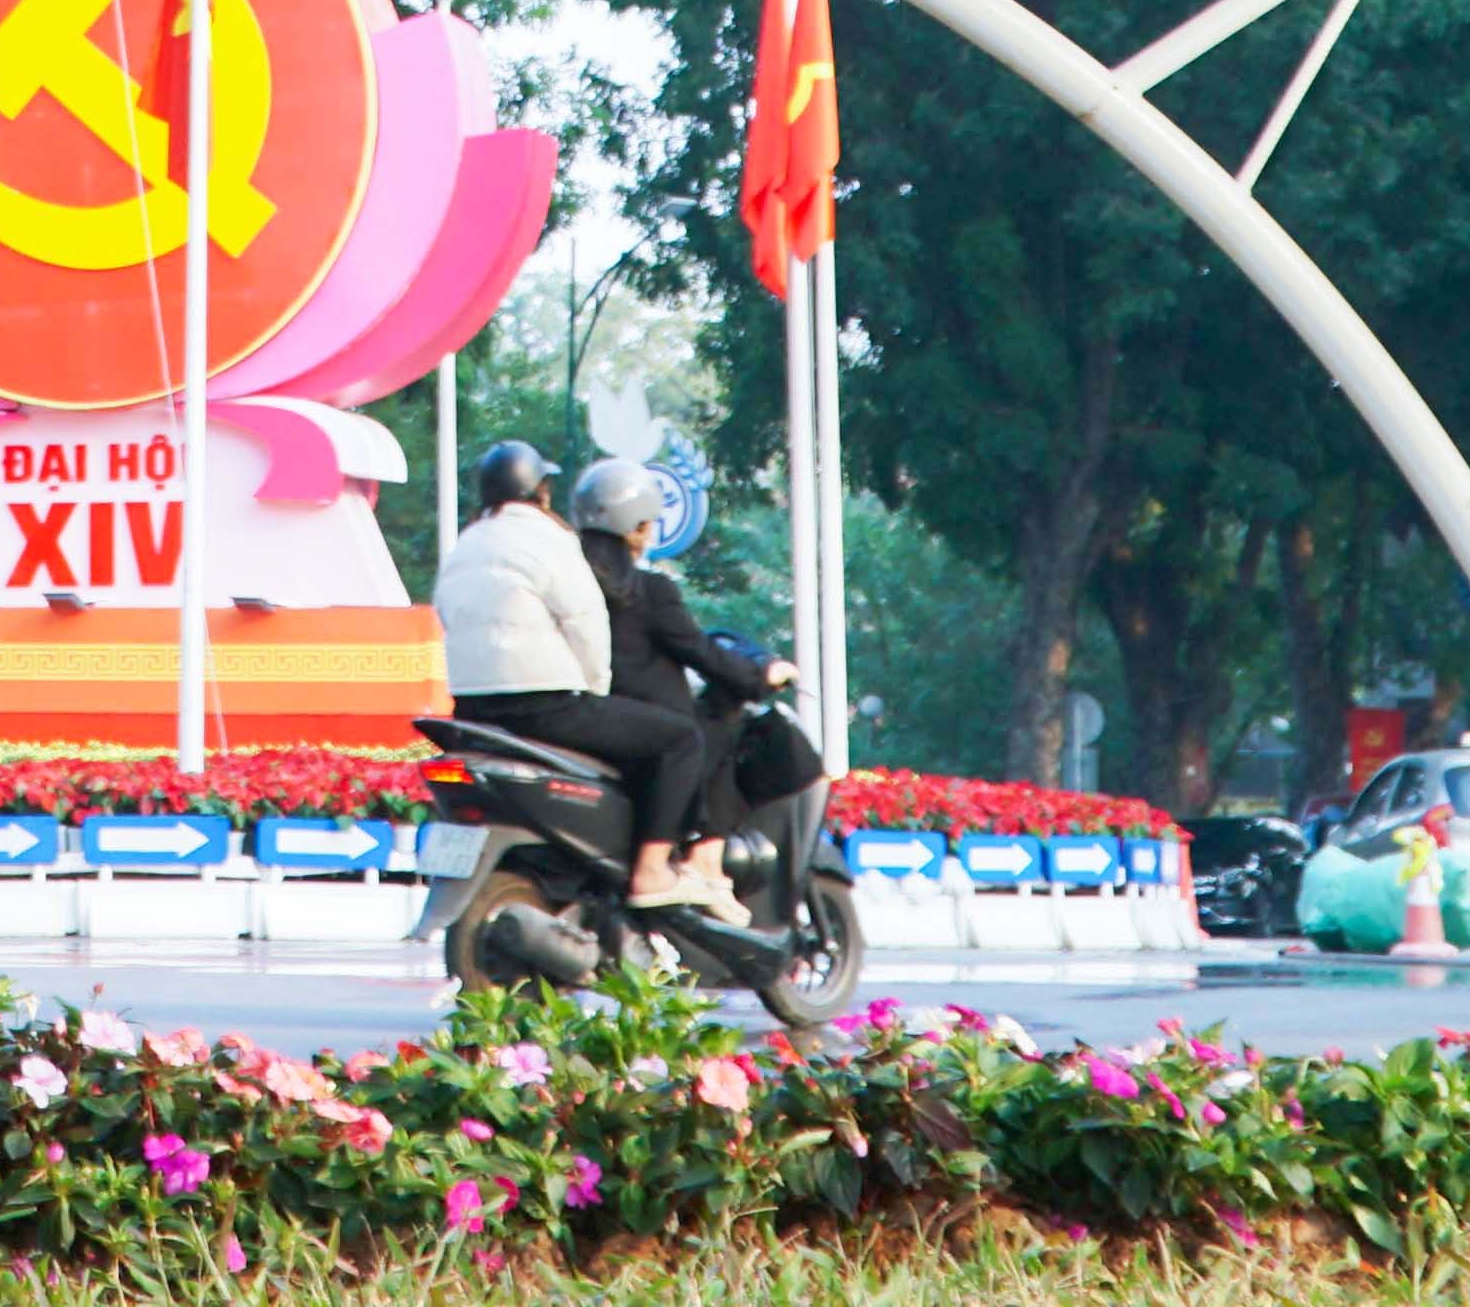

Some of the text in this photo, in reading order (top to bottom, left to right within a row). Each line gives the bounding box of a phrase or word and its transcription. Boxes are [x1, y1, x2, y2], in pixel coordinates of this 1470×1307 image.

[2, 434, 186, 491] ĐẠI HỘ
[5, 501, 185, 587] XIV
